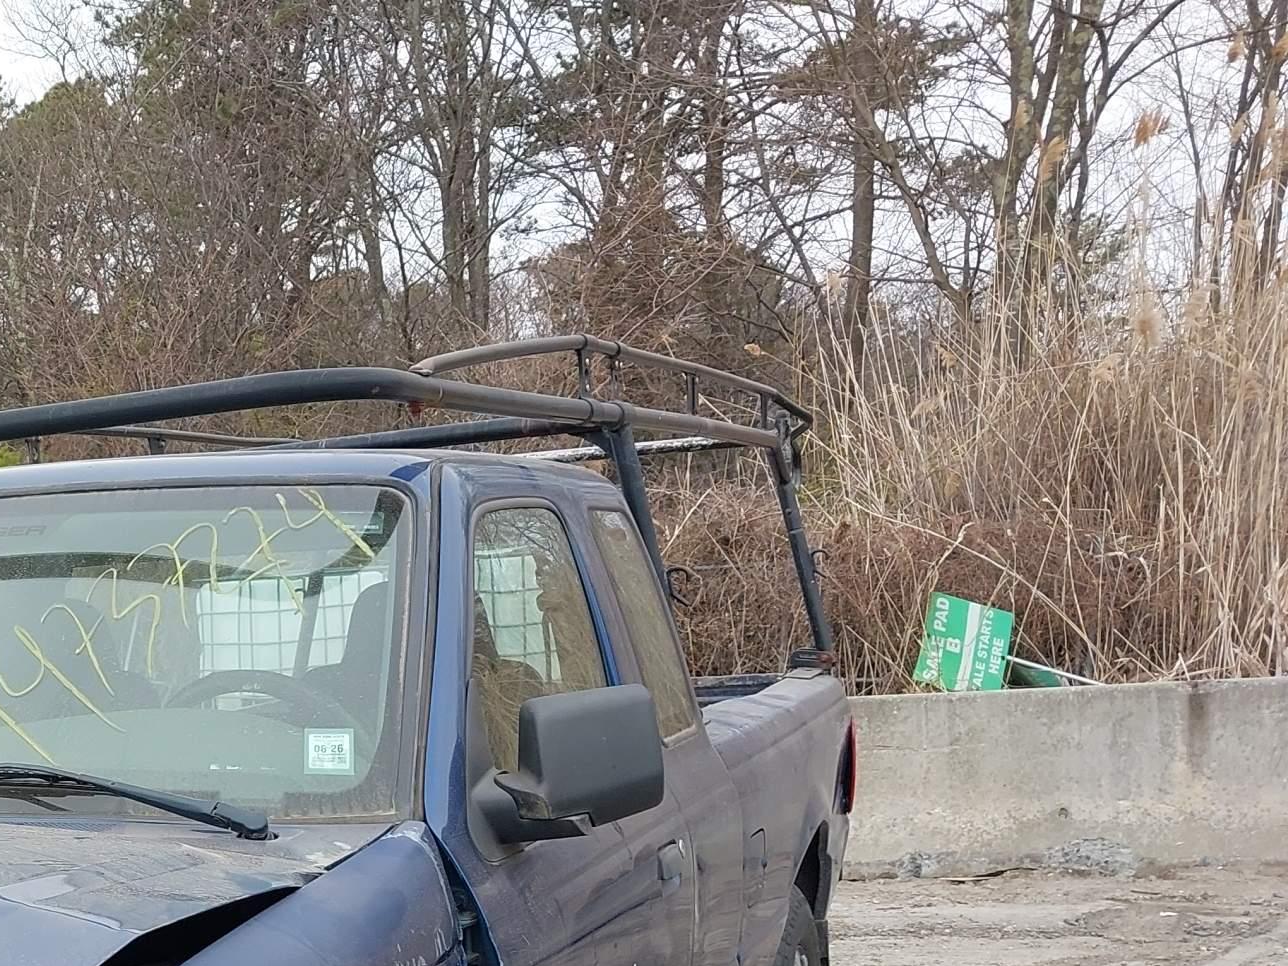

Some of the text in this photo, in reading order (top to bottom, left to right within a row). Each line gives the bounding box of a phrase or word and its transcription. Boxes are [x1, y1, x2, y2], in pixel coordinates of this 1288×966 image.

[933, 597, 950, 632] PAD
[946, 636, 961, 654] B
[977, 610, 994, 659] STARTS
[988, 637, 1005, 674] HERE
